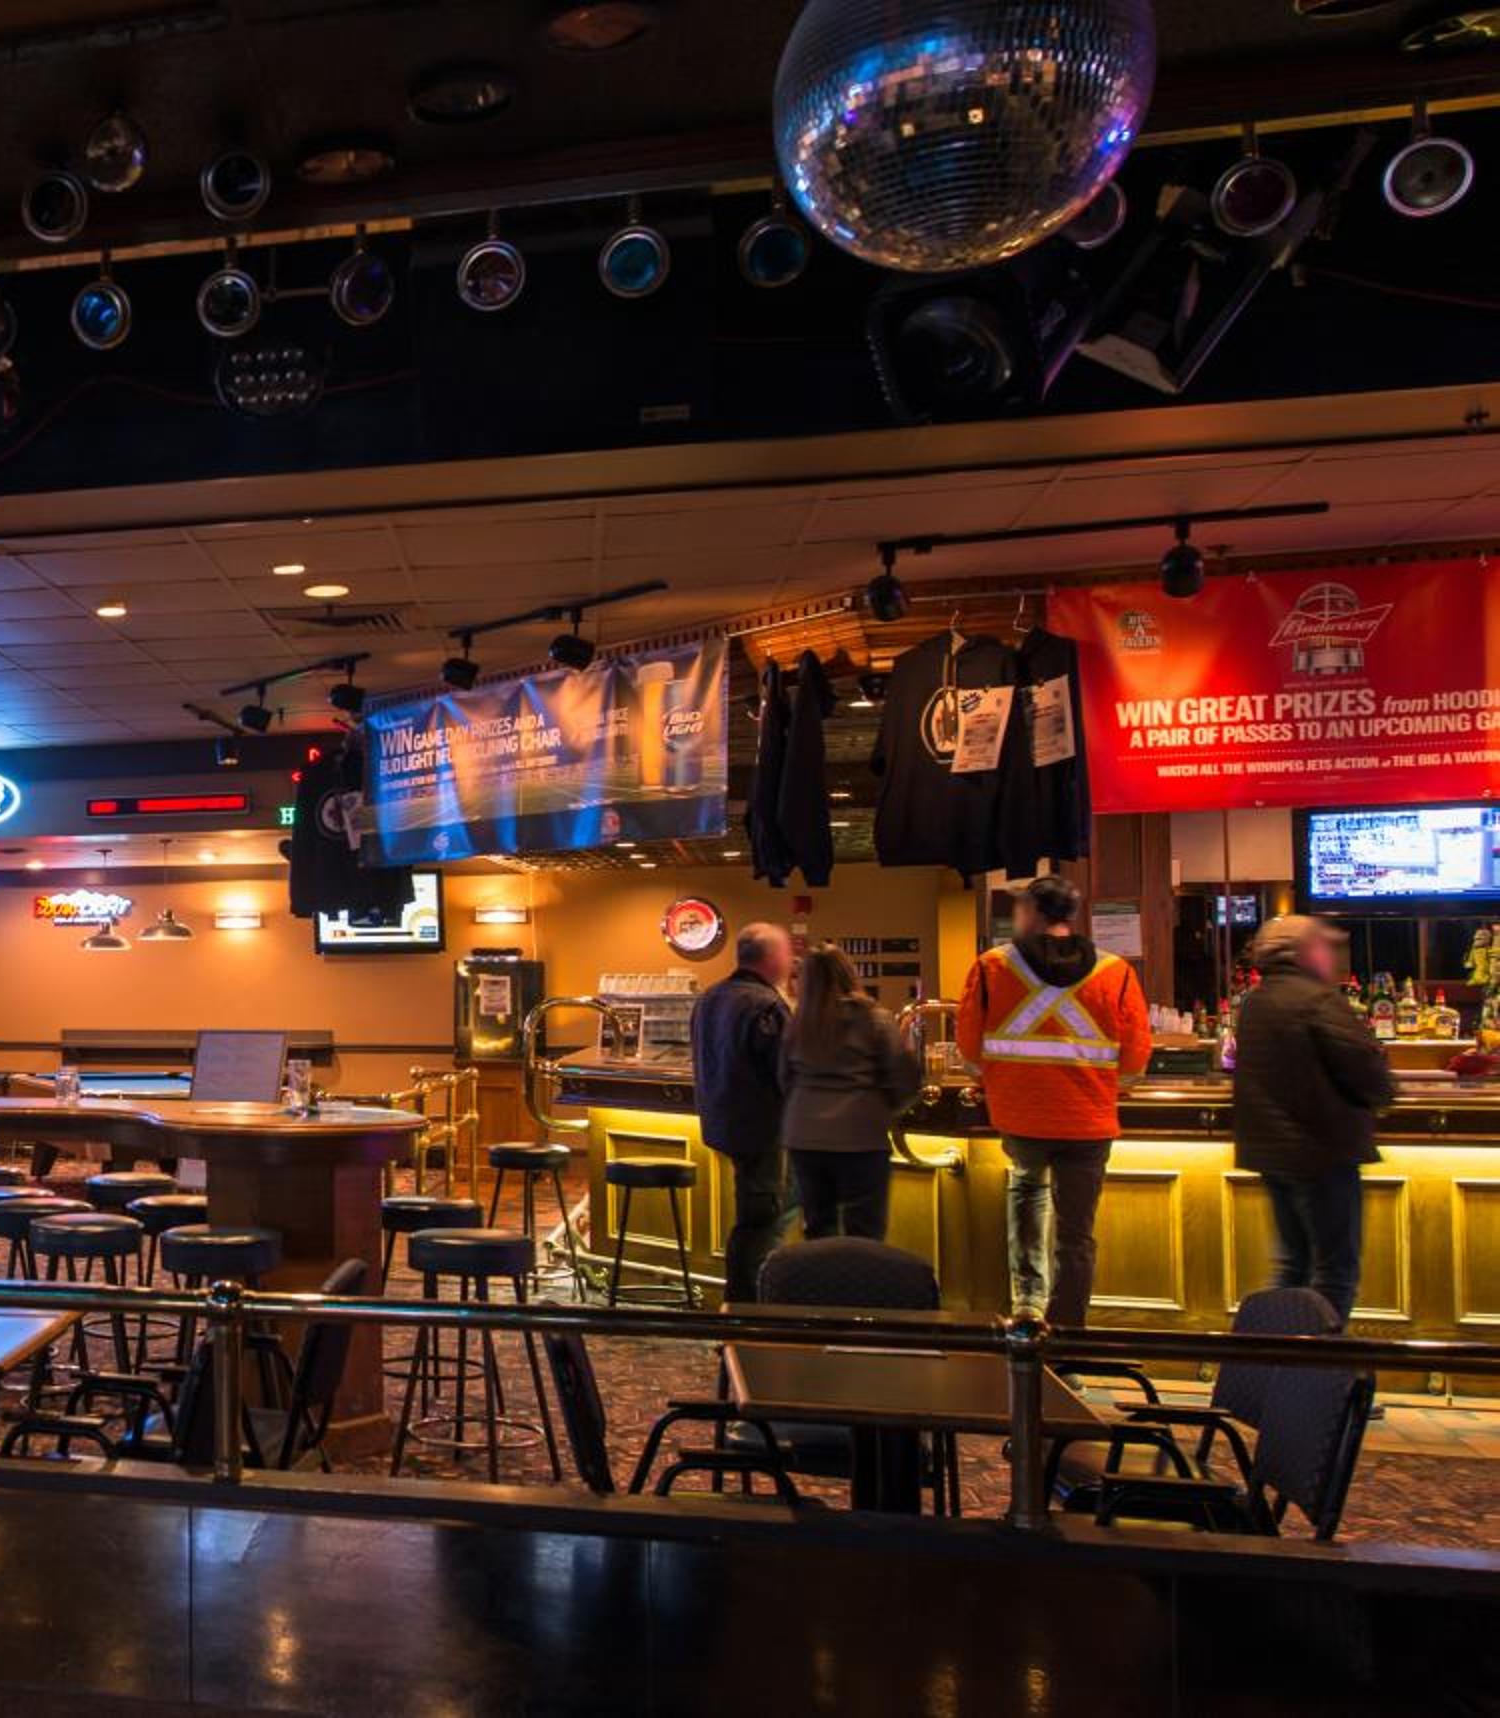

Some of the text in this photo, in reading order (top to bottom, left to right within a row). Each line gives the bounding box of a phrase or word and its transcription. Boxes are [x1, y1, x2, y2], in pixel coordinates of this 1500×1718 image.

[1284, 617, 1379, 638] Budweiser
[669, 711, 701, 725] BUD
[1115, 700, 1173, 728] WIN
[1179, 694, 1268, 724] GREAT
[1274, 689, 1376, 720] PRIZES
[1382, 696, 1429, 714] from
[380, 727, 413, 756] WIN
[414, 729, 444, 750] GAME
[472, 716, 512, 738] PRIZES
[514, 715, 536, 731] AND
[537, 713, 545, 729] A
[664, 721, 704, 738] LIGHT
[1129, 730, 1144, 749] A
[1147, 727, 1190, 748] PAIR
[1194, 726, 1220, 746] OF
[1222, 723, 1294, 744] PASSES
[1296, 721, 1323, 741] TO
[1325, 719, 1355, 739] AN
[1359, 713, 1472, 737] UPCOMING
[380, 758, 402, 776] BUD
[402, 752, 434, 772] LIGHT
[520, 728, 562, 750] CHAIR
[1157, 764, 1199, 778] WATCH
[1200, 763, 1220, 776] ALL
[1222, 761, 1245, 775] THE
[1247, 760, 1305, 774] WINNIPEG
[1306, 758, 1333, 771] JETS
[1334, 756, 1379, 769] ACTION
[1392, 755, 1417, 767] THE
[1418, 753, 1441, 766] BIG
[1442, 752, 1452, 765] A
